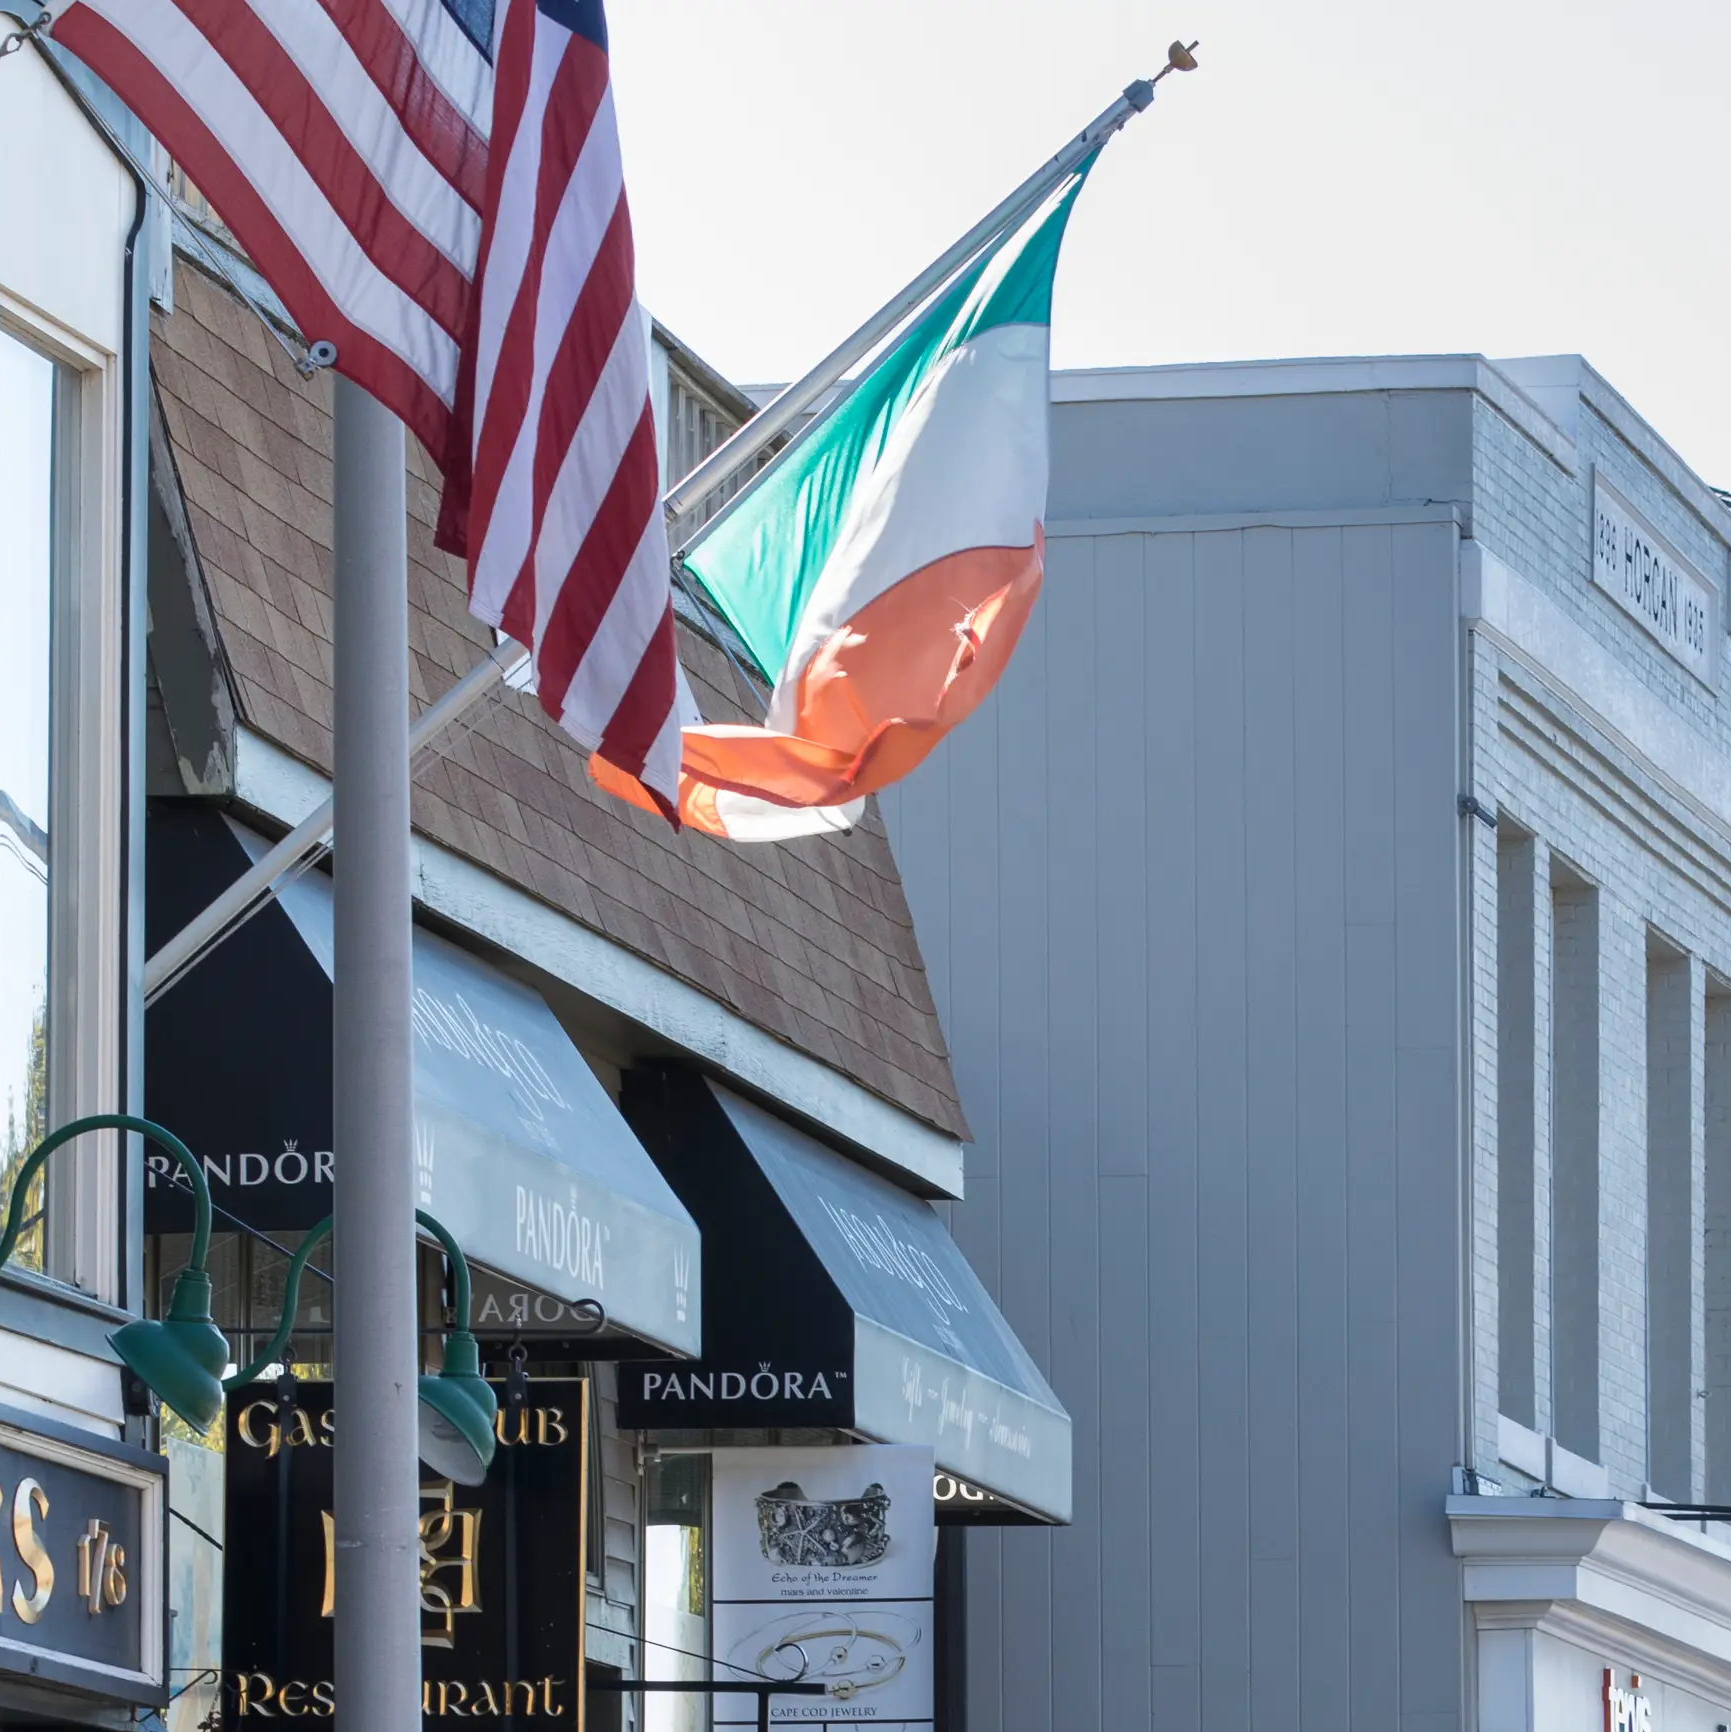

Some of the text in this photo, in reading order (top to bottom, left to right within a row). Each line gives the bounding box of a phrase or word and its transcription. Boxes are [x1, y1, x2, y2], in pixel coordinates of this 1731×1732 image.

[1625, 526, 1678, 642] HORGAN
[148, 1150, 335, 1188] PANDOR
[516, 1185, 604, 1290] PANDORA
[643, 1372, 833, 1400] PANDORA
[77, 1519, 127, 1616] 178
[771, 1572, 878, 1586] Echo of the Dreamer
[780, 1587, 804, 1596] mars
[806, 1586, 825, 1596] and
[771, 1707, 878, 1717] CAPE COD JEWELRY
